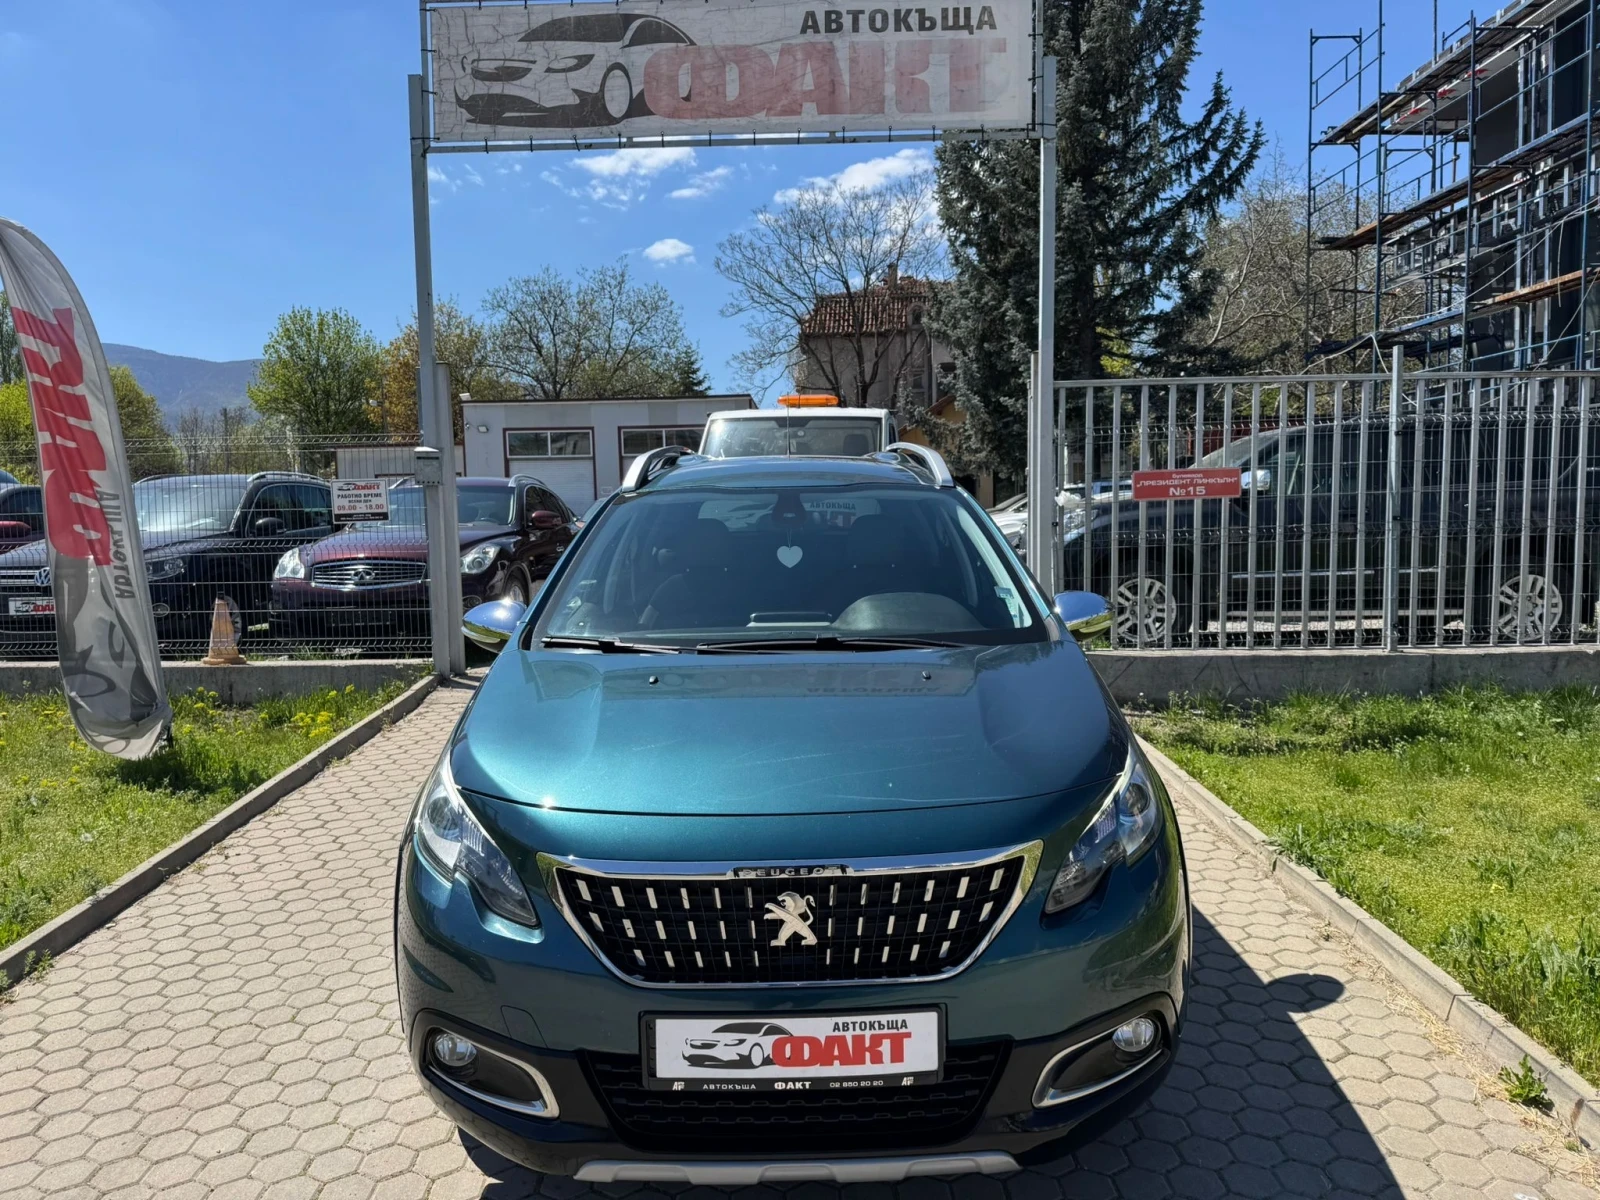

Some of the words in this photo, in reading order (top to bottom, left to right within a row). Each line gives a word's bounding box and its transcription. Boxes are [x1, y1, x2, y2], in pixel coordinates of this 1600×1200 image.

[800, 5, 997, 35] АВТОКЪЩА
[643, 37, 1007, 120] ФАКТ
[742, 866, 838, 877] PEUGEOT
[832, 1018, 908, 1033] АВТОКЪЩА
[771, 1031, 912, 1068] ФАКТ
[774, 1081, 812, 1090] ФАКТ
